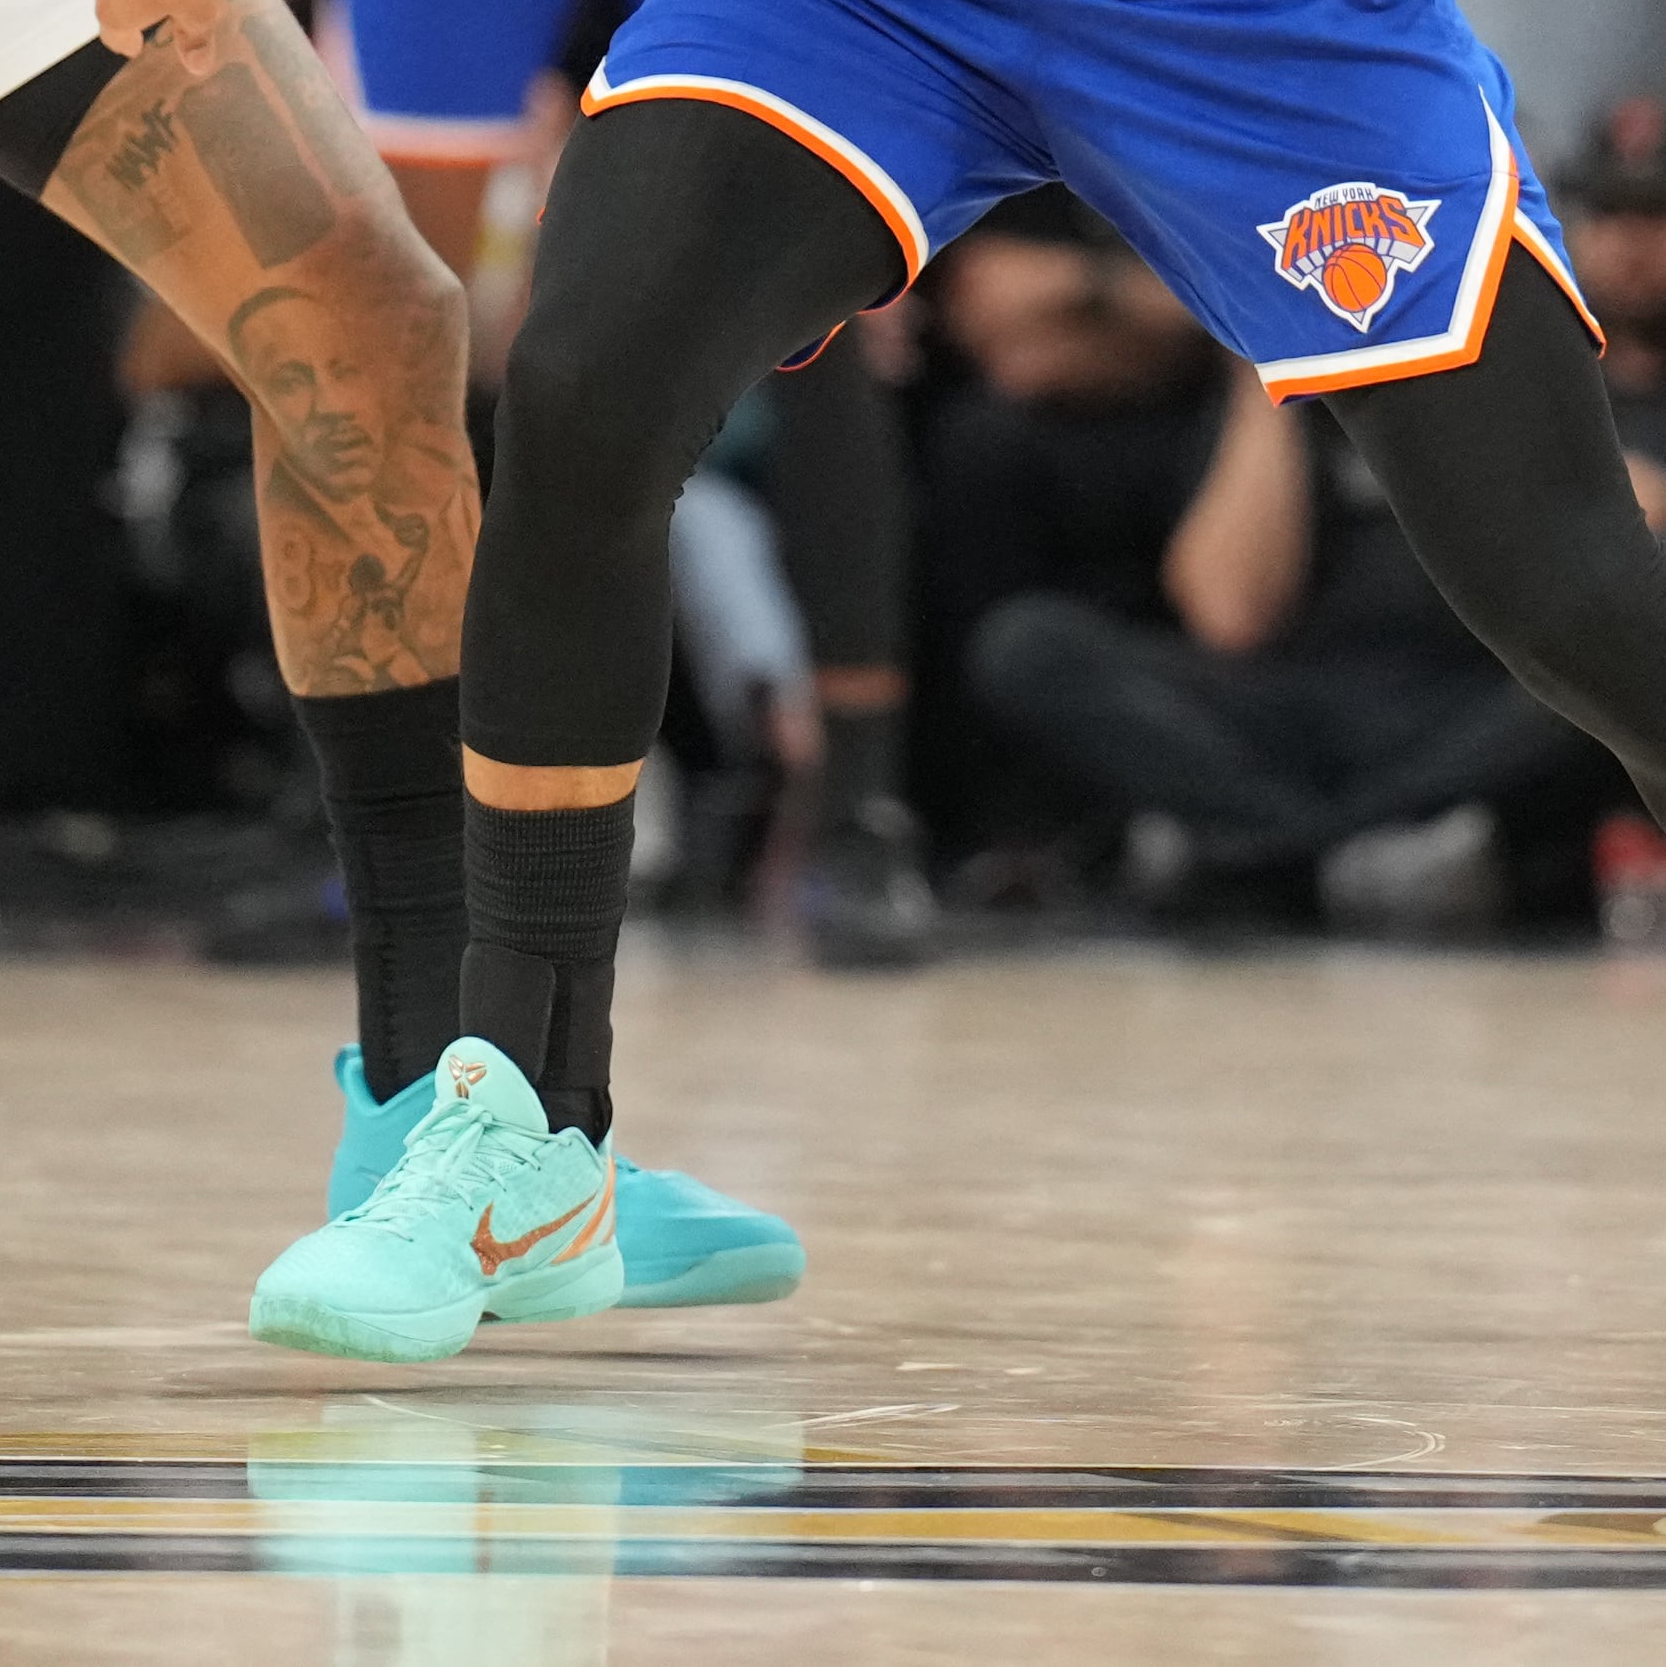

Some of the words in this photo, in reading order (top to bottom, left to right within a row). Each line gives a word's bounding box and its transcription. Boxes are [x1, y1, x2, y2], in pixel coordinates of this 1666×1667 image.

[1313, 189, 1340, 210] NEW
[1341, 187, 1374, 201] YORK
[1281, 195, 1426, 271] KNICKS
